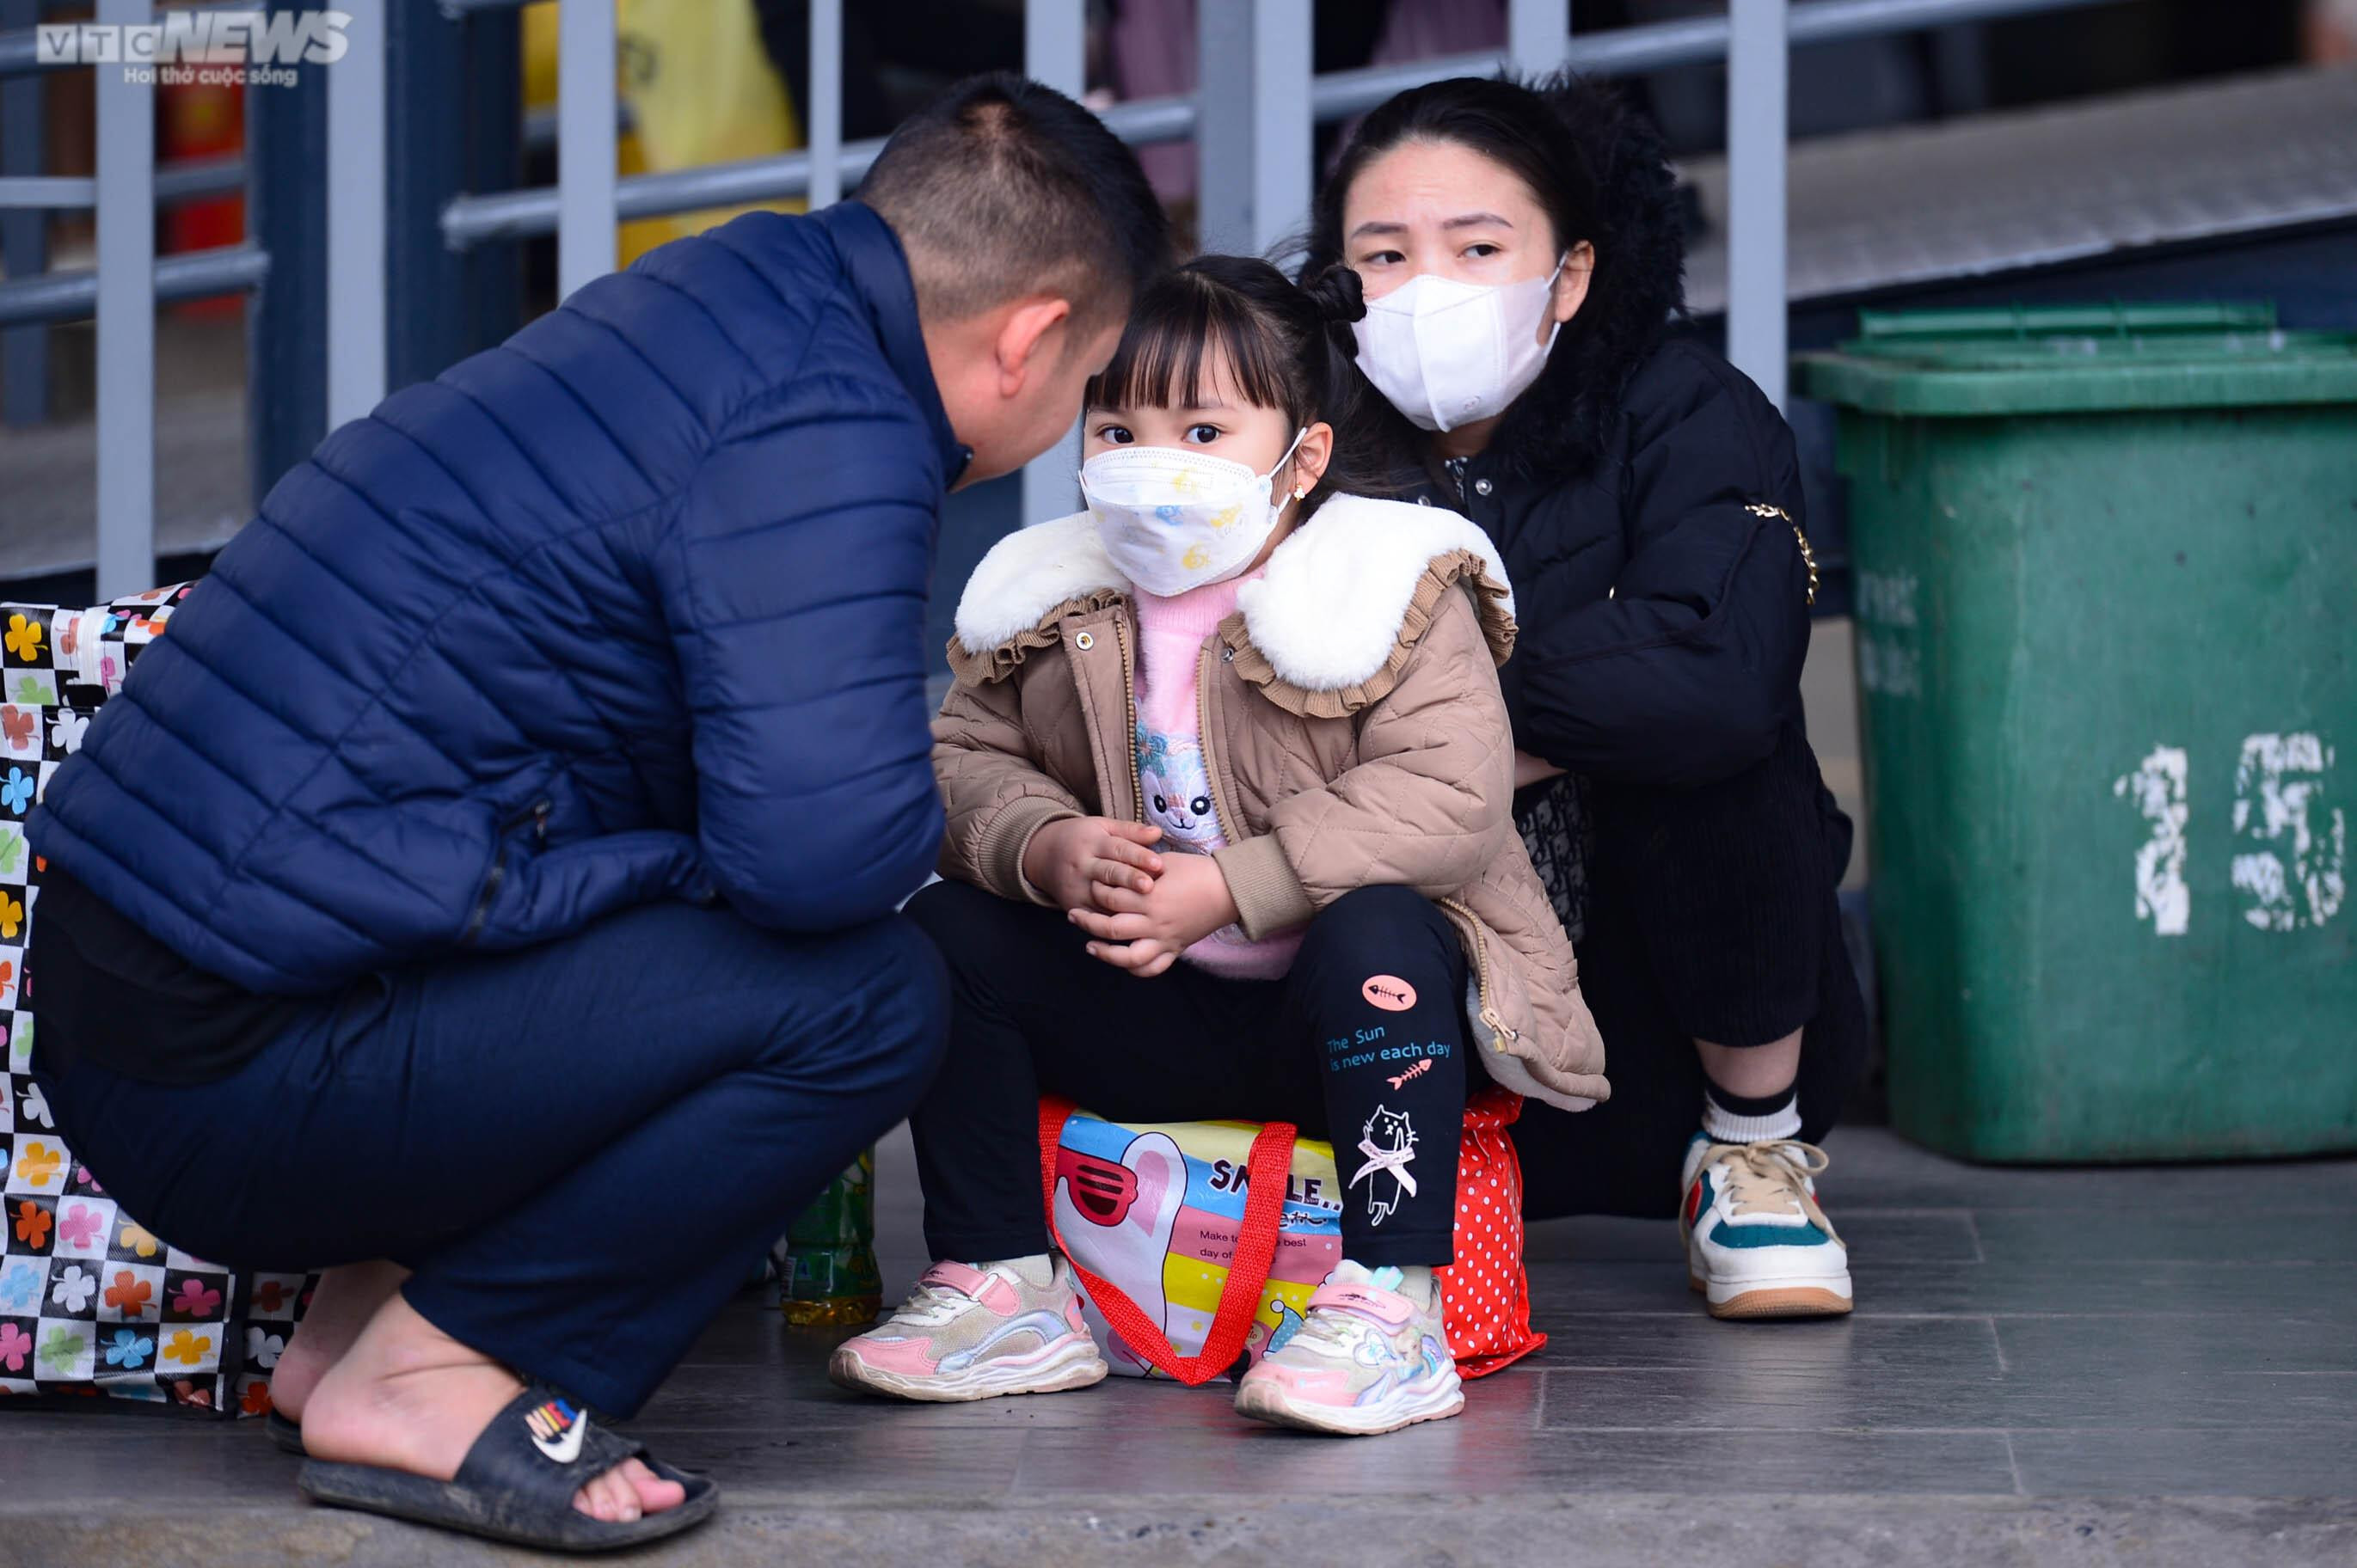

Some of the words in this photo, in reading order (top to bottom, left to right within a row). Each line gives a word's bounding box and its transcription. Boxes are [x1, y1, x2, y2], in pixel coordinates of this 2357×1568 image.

[1328, 1038, 1349, 1053] The
[1355, 1026, 1385, 1044] Sun
[1330, 1058, 1340, 1071] is
[1342, 1051, 1376, 1069] new
[1380, 1043, 1422, 1060] each
[1427, 1040, 1451, 1058] day
[1200, 1230, 1229, 1242] Make
[1283, 1238, 1307, 1246] best
[1200, 1248, 1219, 1259] day
